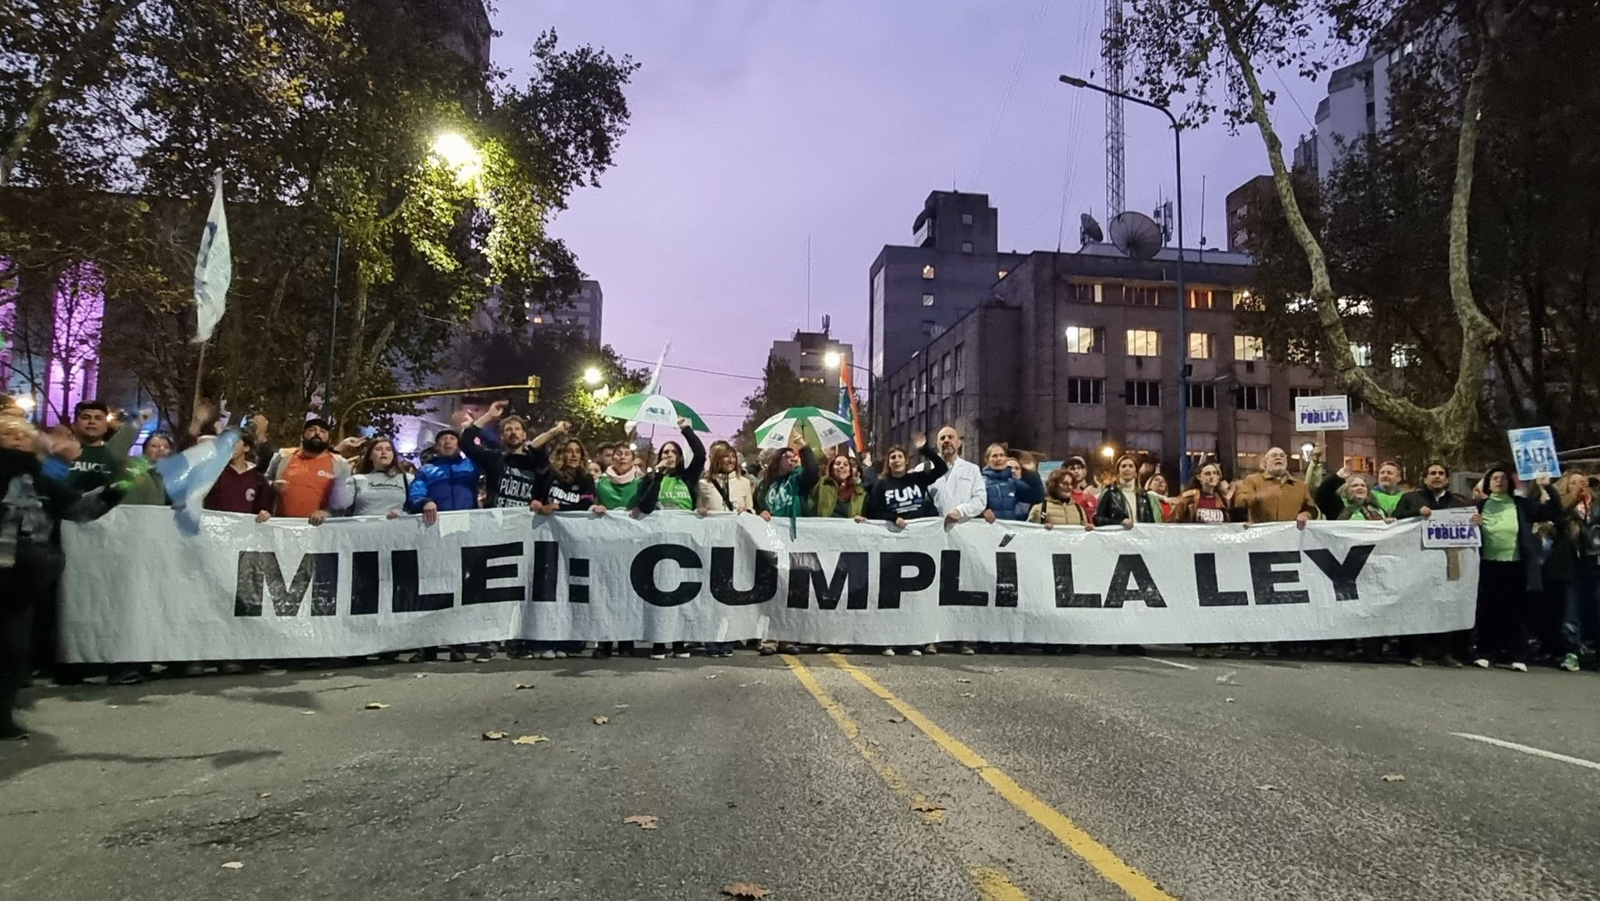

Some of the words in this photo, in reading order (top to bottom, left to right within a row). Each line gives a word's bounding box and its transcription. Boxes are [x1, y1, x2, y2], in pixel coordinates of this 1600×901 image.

[885, 484, 922, 504] FUM
[233, 539, 590, 617] MILEI:
[629, 534, 1019, 611] CUMPLÍ
[1051, 553, 1168, 609] LA
[1193, 544, 1377, 606] LEY
